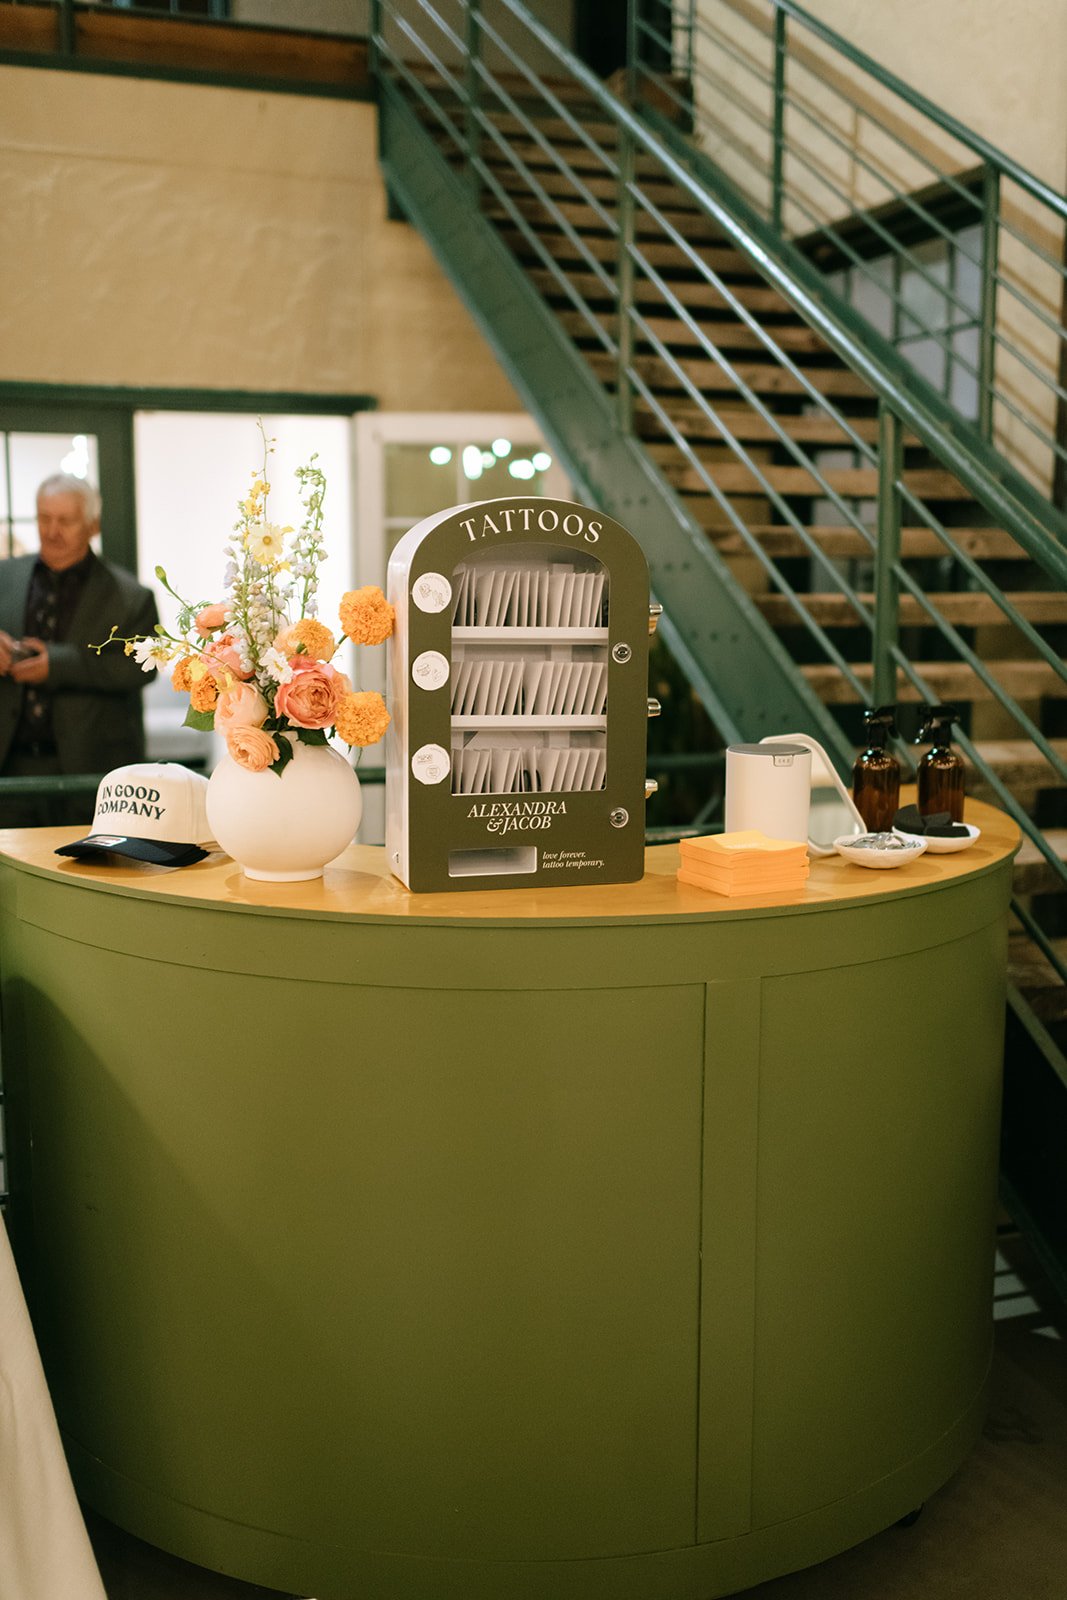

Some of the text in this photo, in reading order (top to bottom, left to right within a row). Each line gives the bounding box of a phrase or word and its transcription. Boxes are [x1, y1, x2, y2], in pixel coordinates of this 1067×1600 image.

[459, 508, 603, 543] TATTOOS
[102, 784, 161, 803] IN GOOD
[97, 800, 166, 820] COMPANY
[467, 801, 567, 818] ALEXANDRA
[542, 850, 587, 861] love forever.
[542, 859, 605, 869] tattoo temporary.
